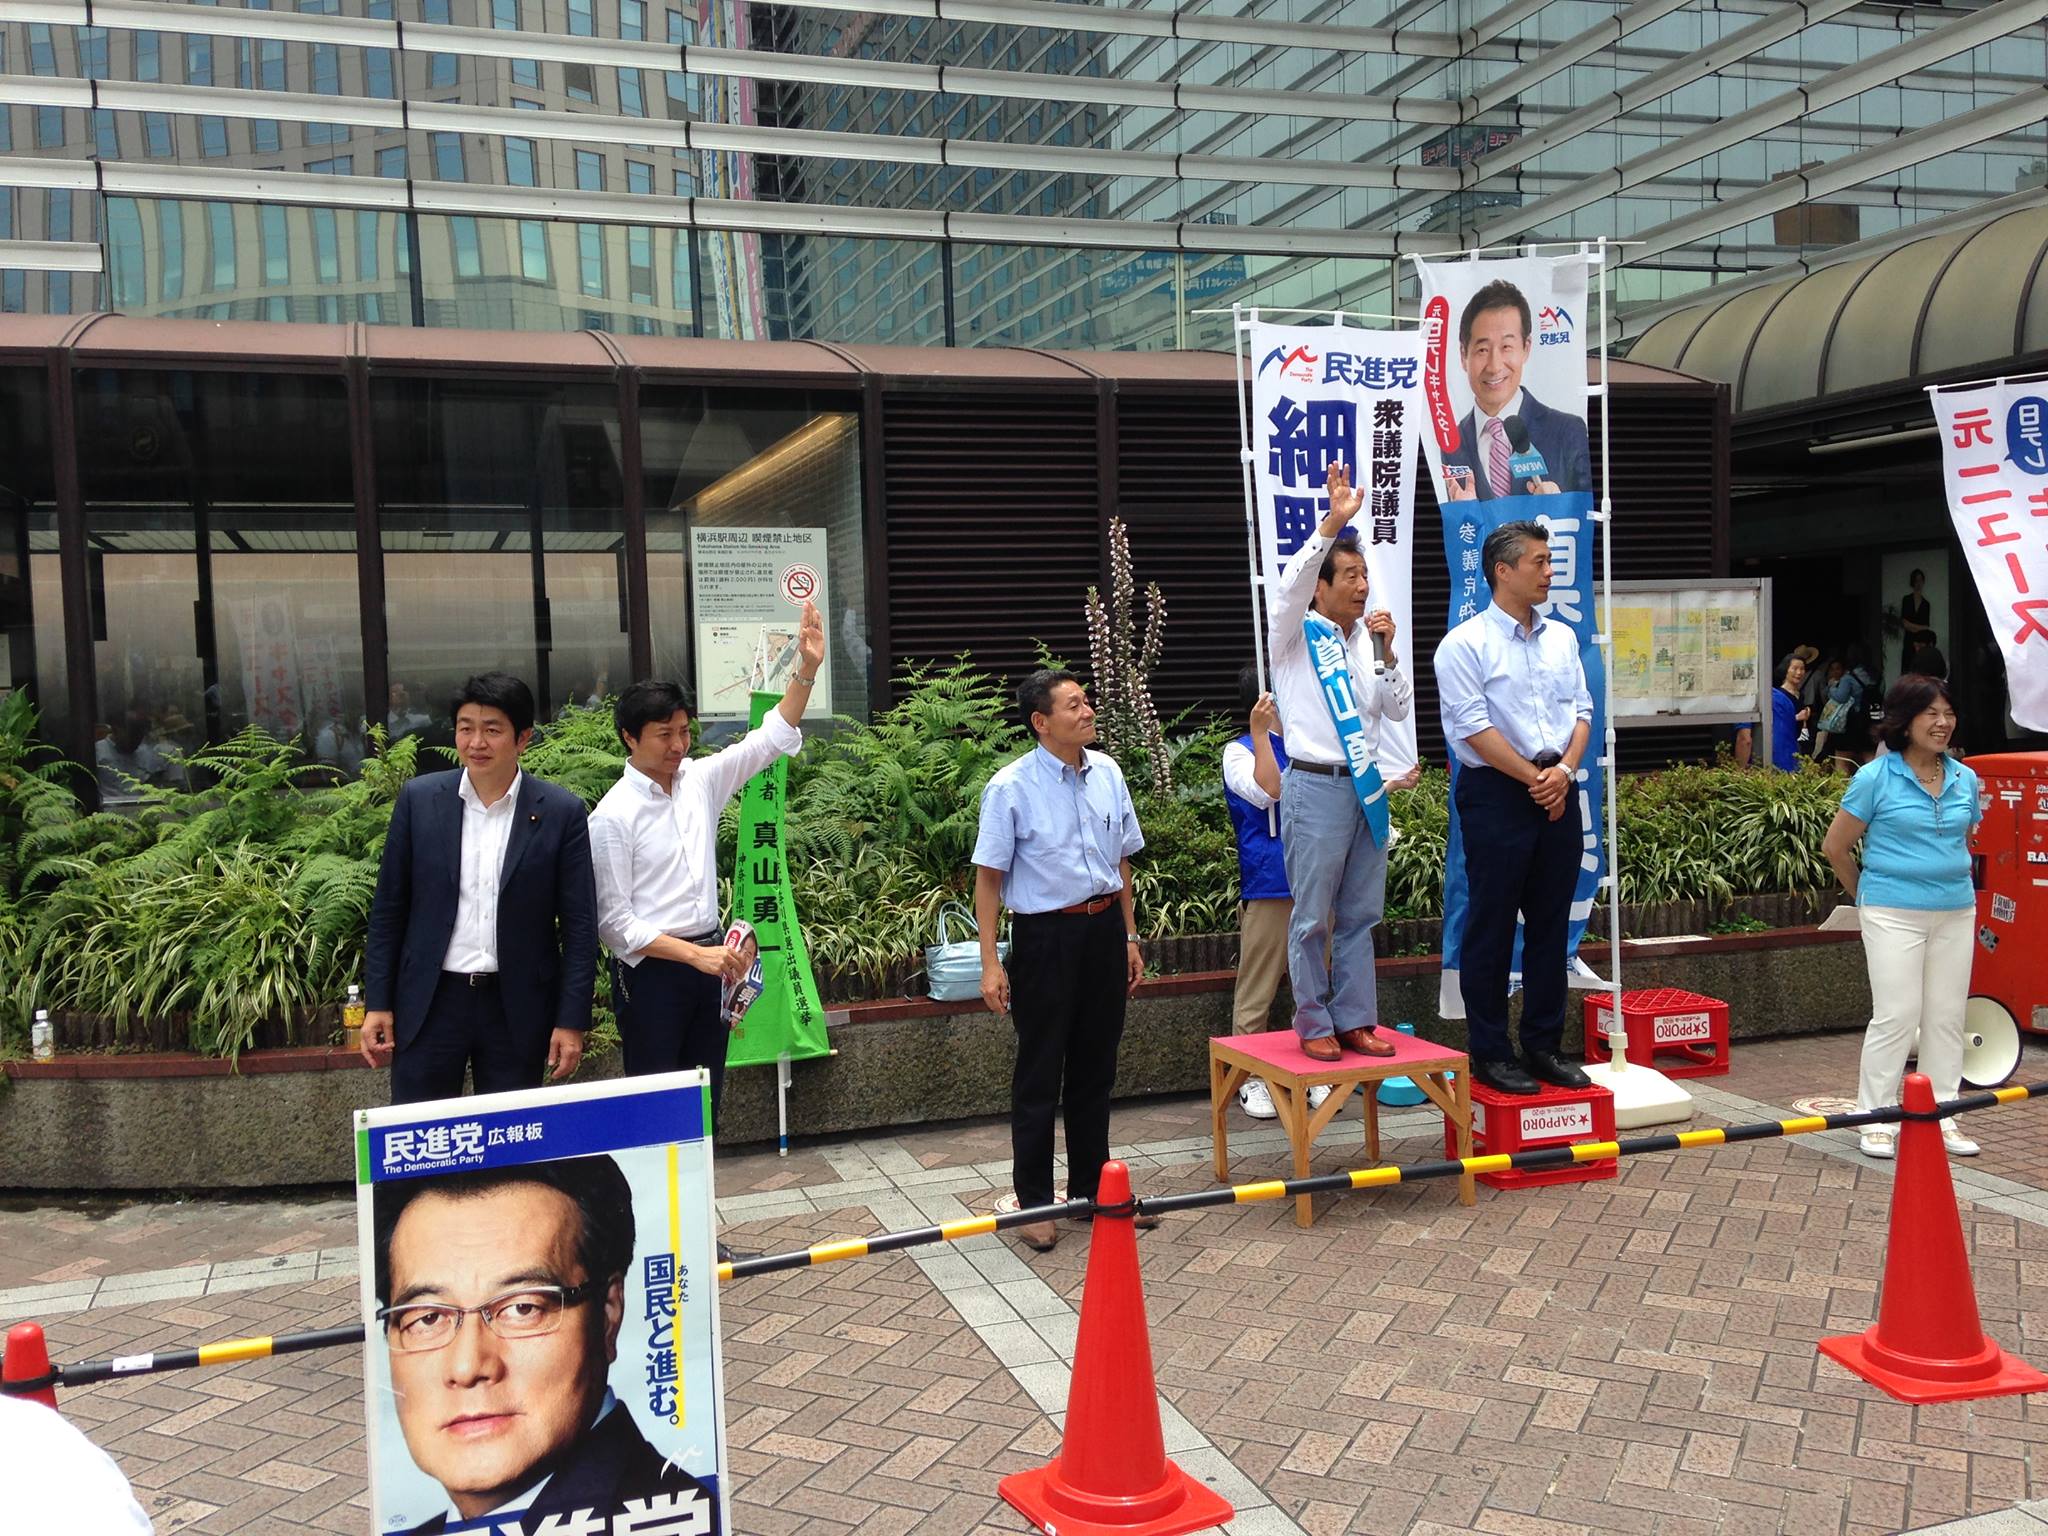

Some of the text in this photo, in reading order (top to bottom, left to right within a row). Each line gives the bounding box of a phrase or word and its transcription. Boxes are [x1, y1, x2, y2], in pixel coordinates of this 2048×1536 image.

[1322, 352, 1418, 390] 民進党
[1371, 399, 1404, 545] 衆議院議員
[696, 532, 812, 544] 横浜駅周辺 喫煙禁止地区
[753, 821, 780, 951] 真山勇一
[1523, 1114, 1576, 1131] SAPPORO
[383, 1121, 544, 1167] 民進党 広報板
[384, 1153, 485, 1175] The Democratic Party
[677, 1264, 689, 1303] あなた
[643, 1253, 680, 1426] 国民と進む。
